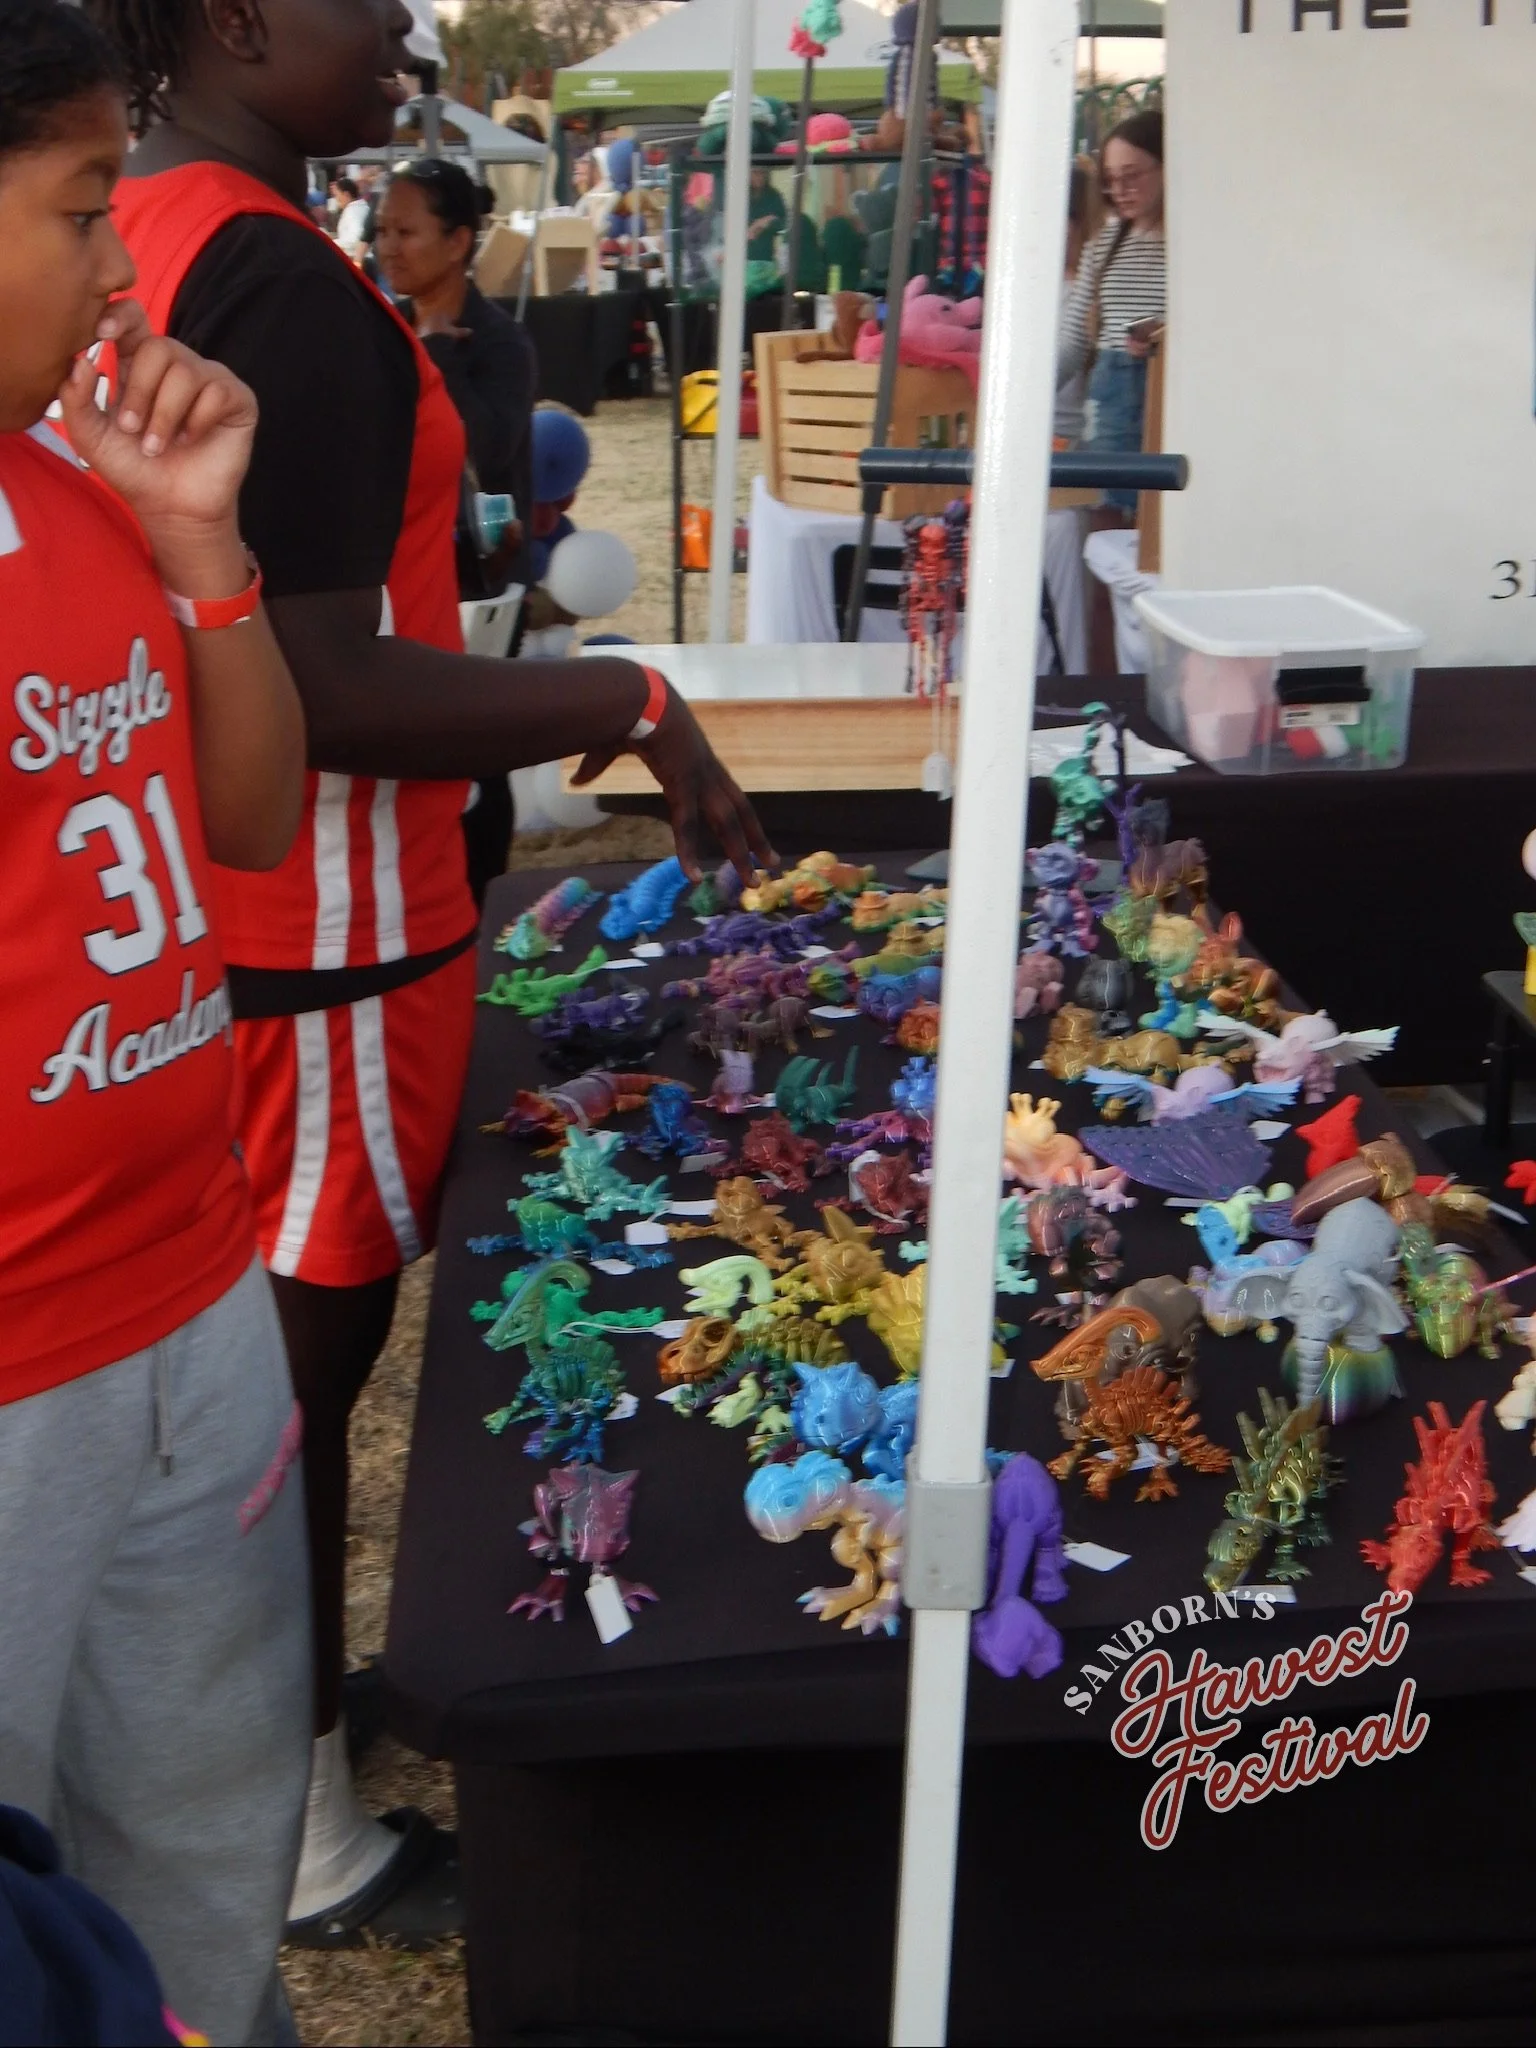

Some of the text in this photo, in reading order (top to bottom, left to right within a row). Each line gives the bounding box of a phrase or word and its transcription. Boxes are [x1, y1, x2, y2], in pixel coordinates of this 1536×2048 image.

[1489, 559, 1536, 600] 3
[10, 637, 171, 776] Sizzle
[57, 771, 208, 976] 31
